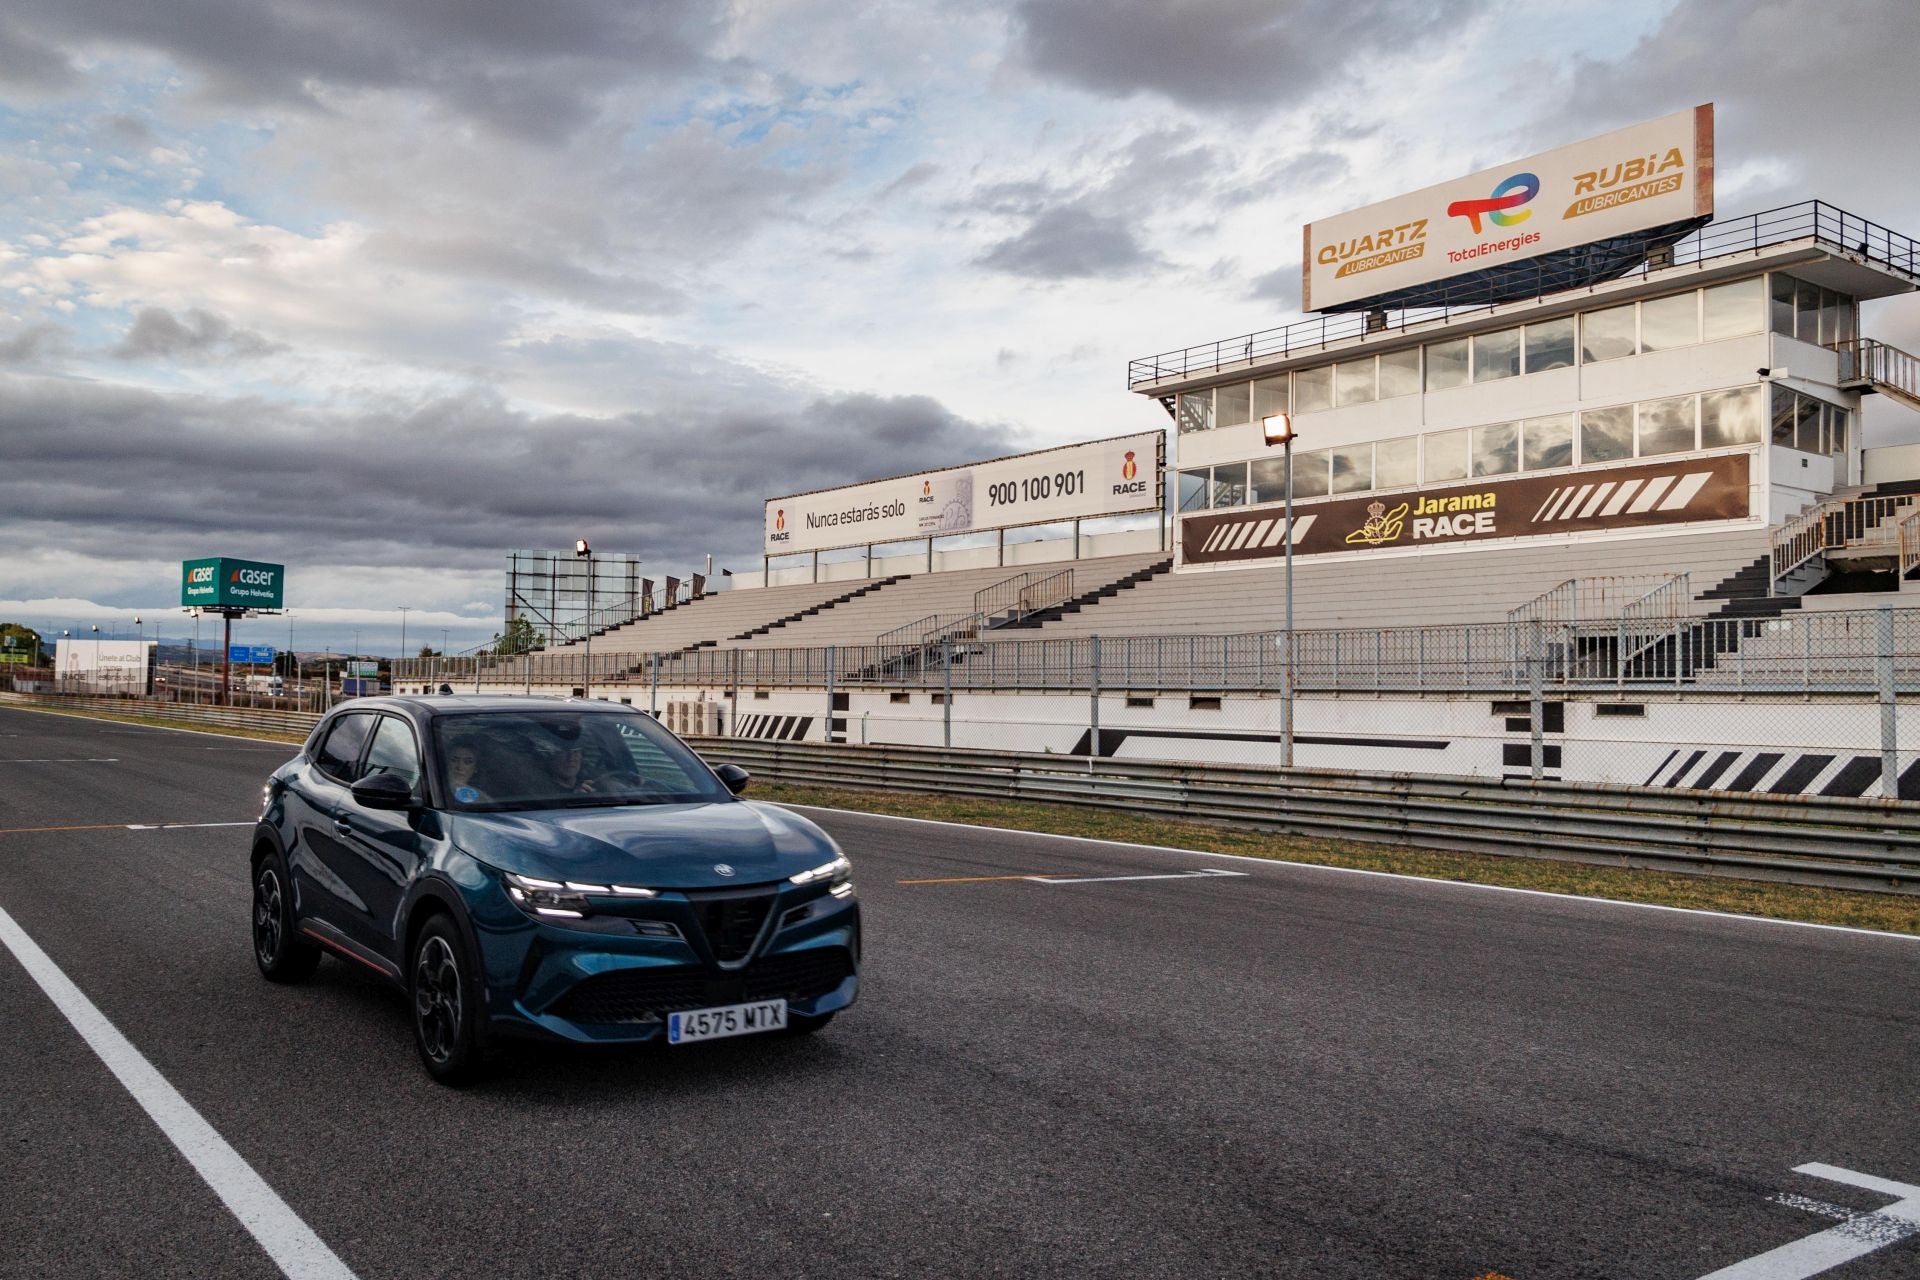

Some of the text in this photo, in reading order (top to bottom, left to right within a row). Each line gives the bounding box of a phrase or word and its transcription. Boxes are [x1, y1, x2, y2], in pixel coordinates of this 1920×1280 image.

[1576, 177, 1677, 215] LUBRICANTES
[1317, 218, 1428, 265] QUARTZ
[1447, 232, 1540, 264] TotalEnergies
[1345, 244, 1421, 275] LUBRICANTES
[989, 470, 1084, 507] 900 100 901
[1112, 481, 1146, 495] RACE
[806, 499, 905, 529] Nunca estarás solo
[1413, 492, 1496, 516] Jarama
[770, 531, 790, 542] RACE
[1413, 511, 1496, 539] RACE
[193, 566, 214, 582] caser
[240, 568, 274, 585] caser
[230, 586, 249, 597] Grupo
[684, 1003, 782, 1036] 4575 MTX
